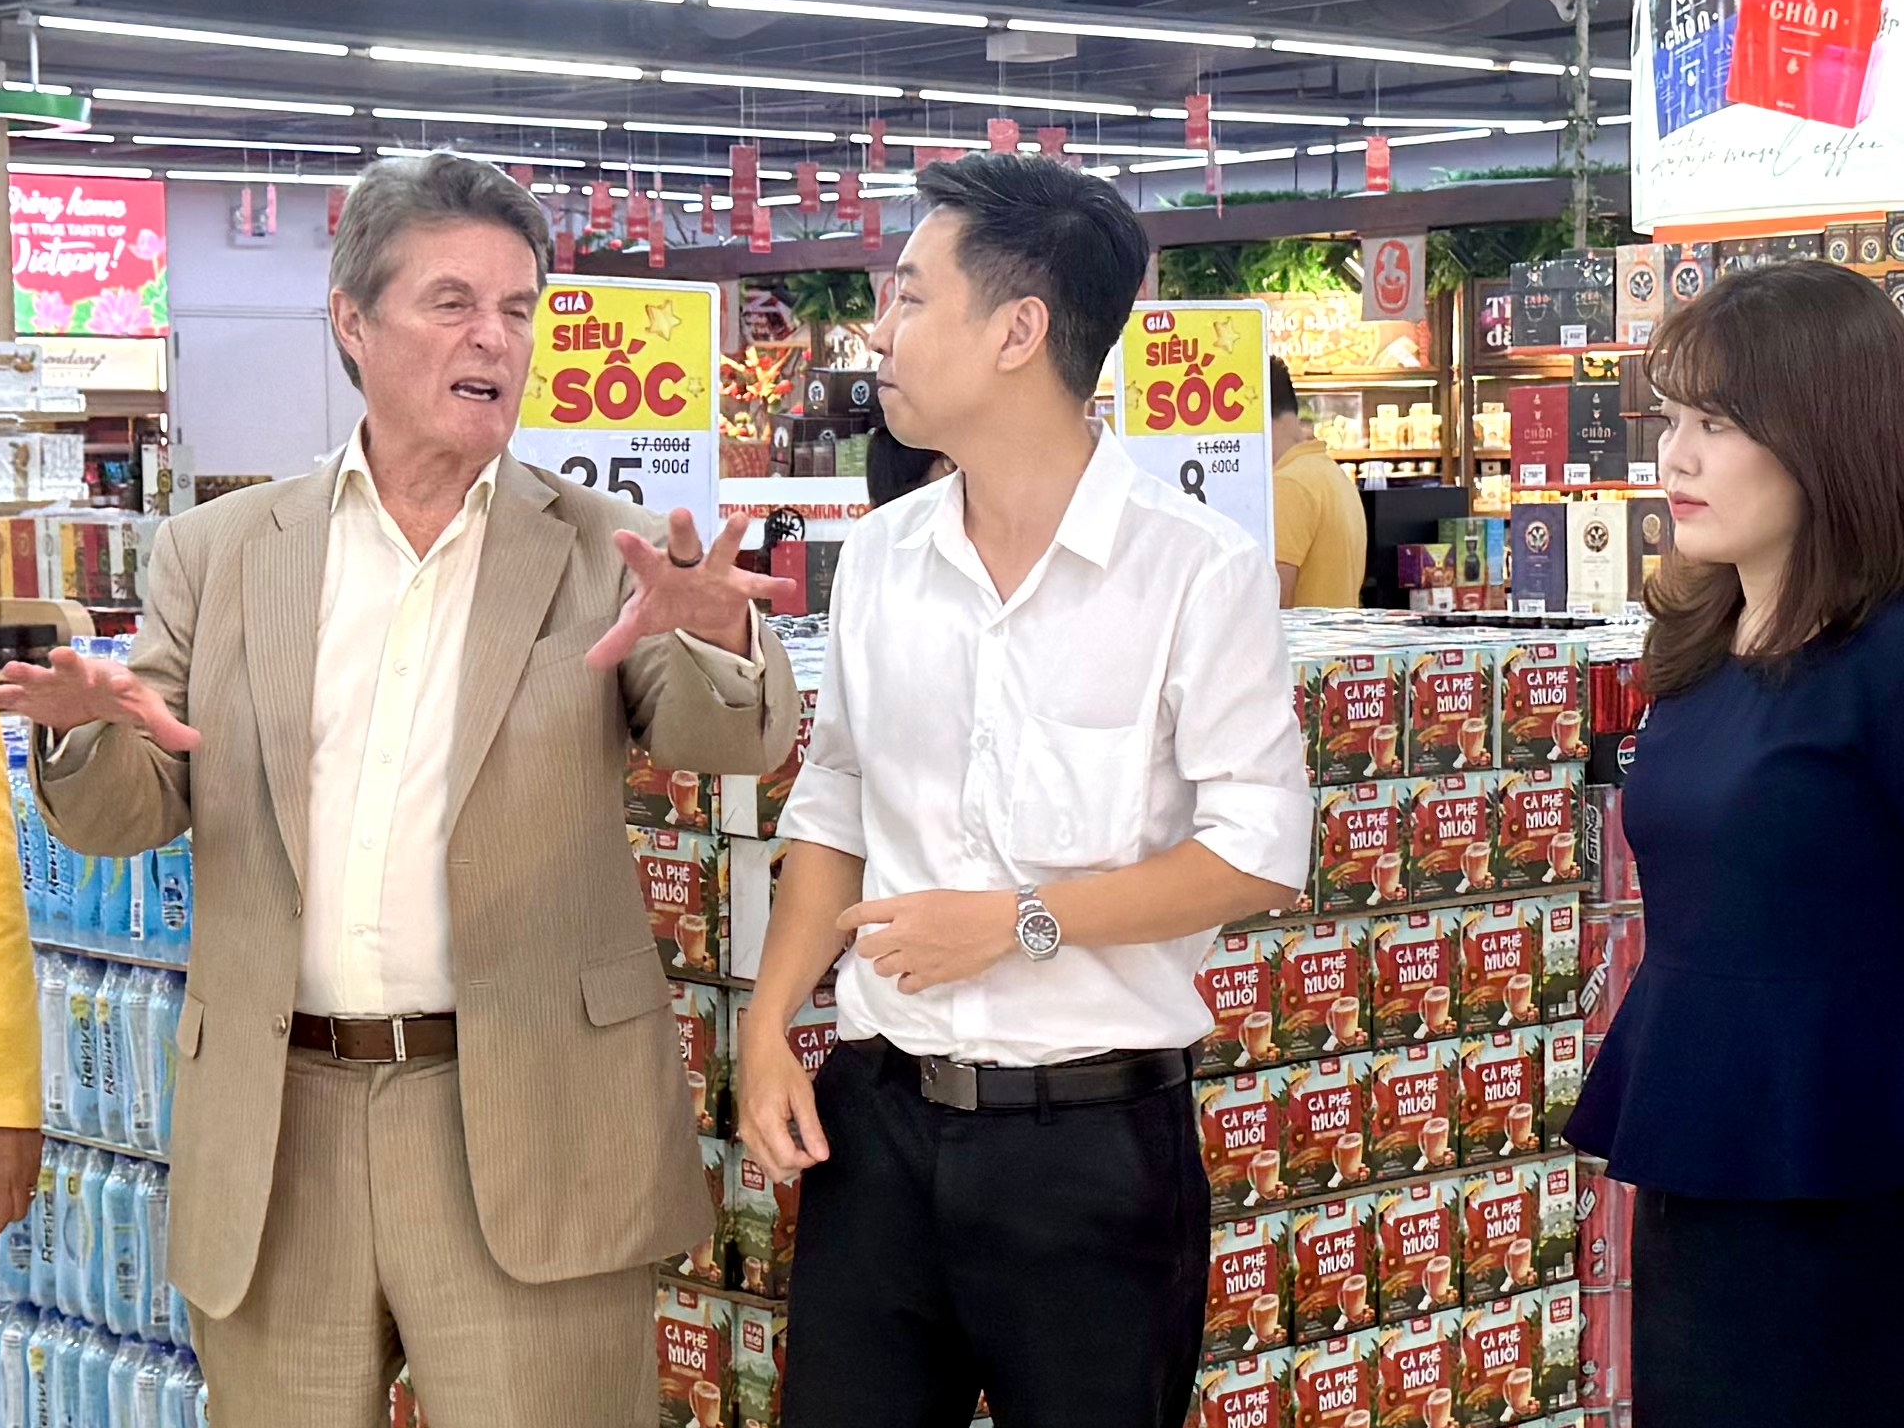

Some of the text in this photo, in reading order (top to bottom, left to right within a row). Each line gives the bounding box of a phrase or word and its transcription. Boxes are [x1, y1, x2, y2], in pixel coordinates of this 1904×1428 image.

[66, 186, 127, 217] home
[554, 292, 587, 312] GIÁ
[552, 315, 623, 352] SIÊU
[1146, 312, 1171, 331] GIÁ
[1145, 334, 1198, 367] SIÊU
[550, 338, 687, 423] SỐC
[1145, 353, 1244, 431] SỐC
[1344, 682, 1361, 700] CÀ
[647, 862, 665, 879] CÀ
